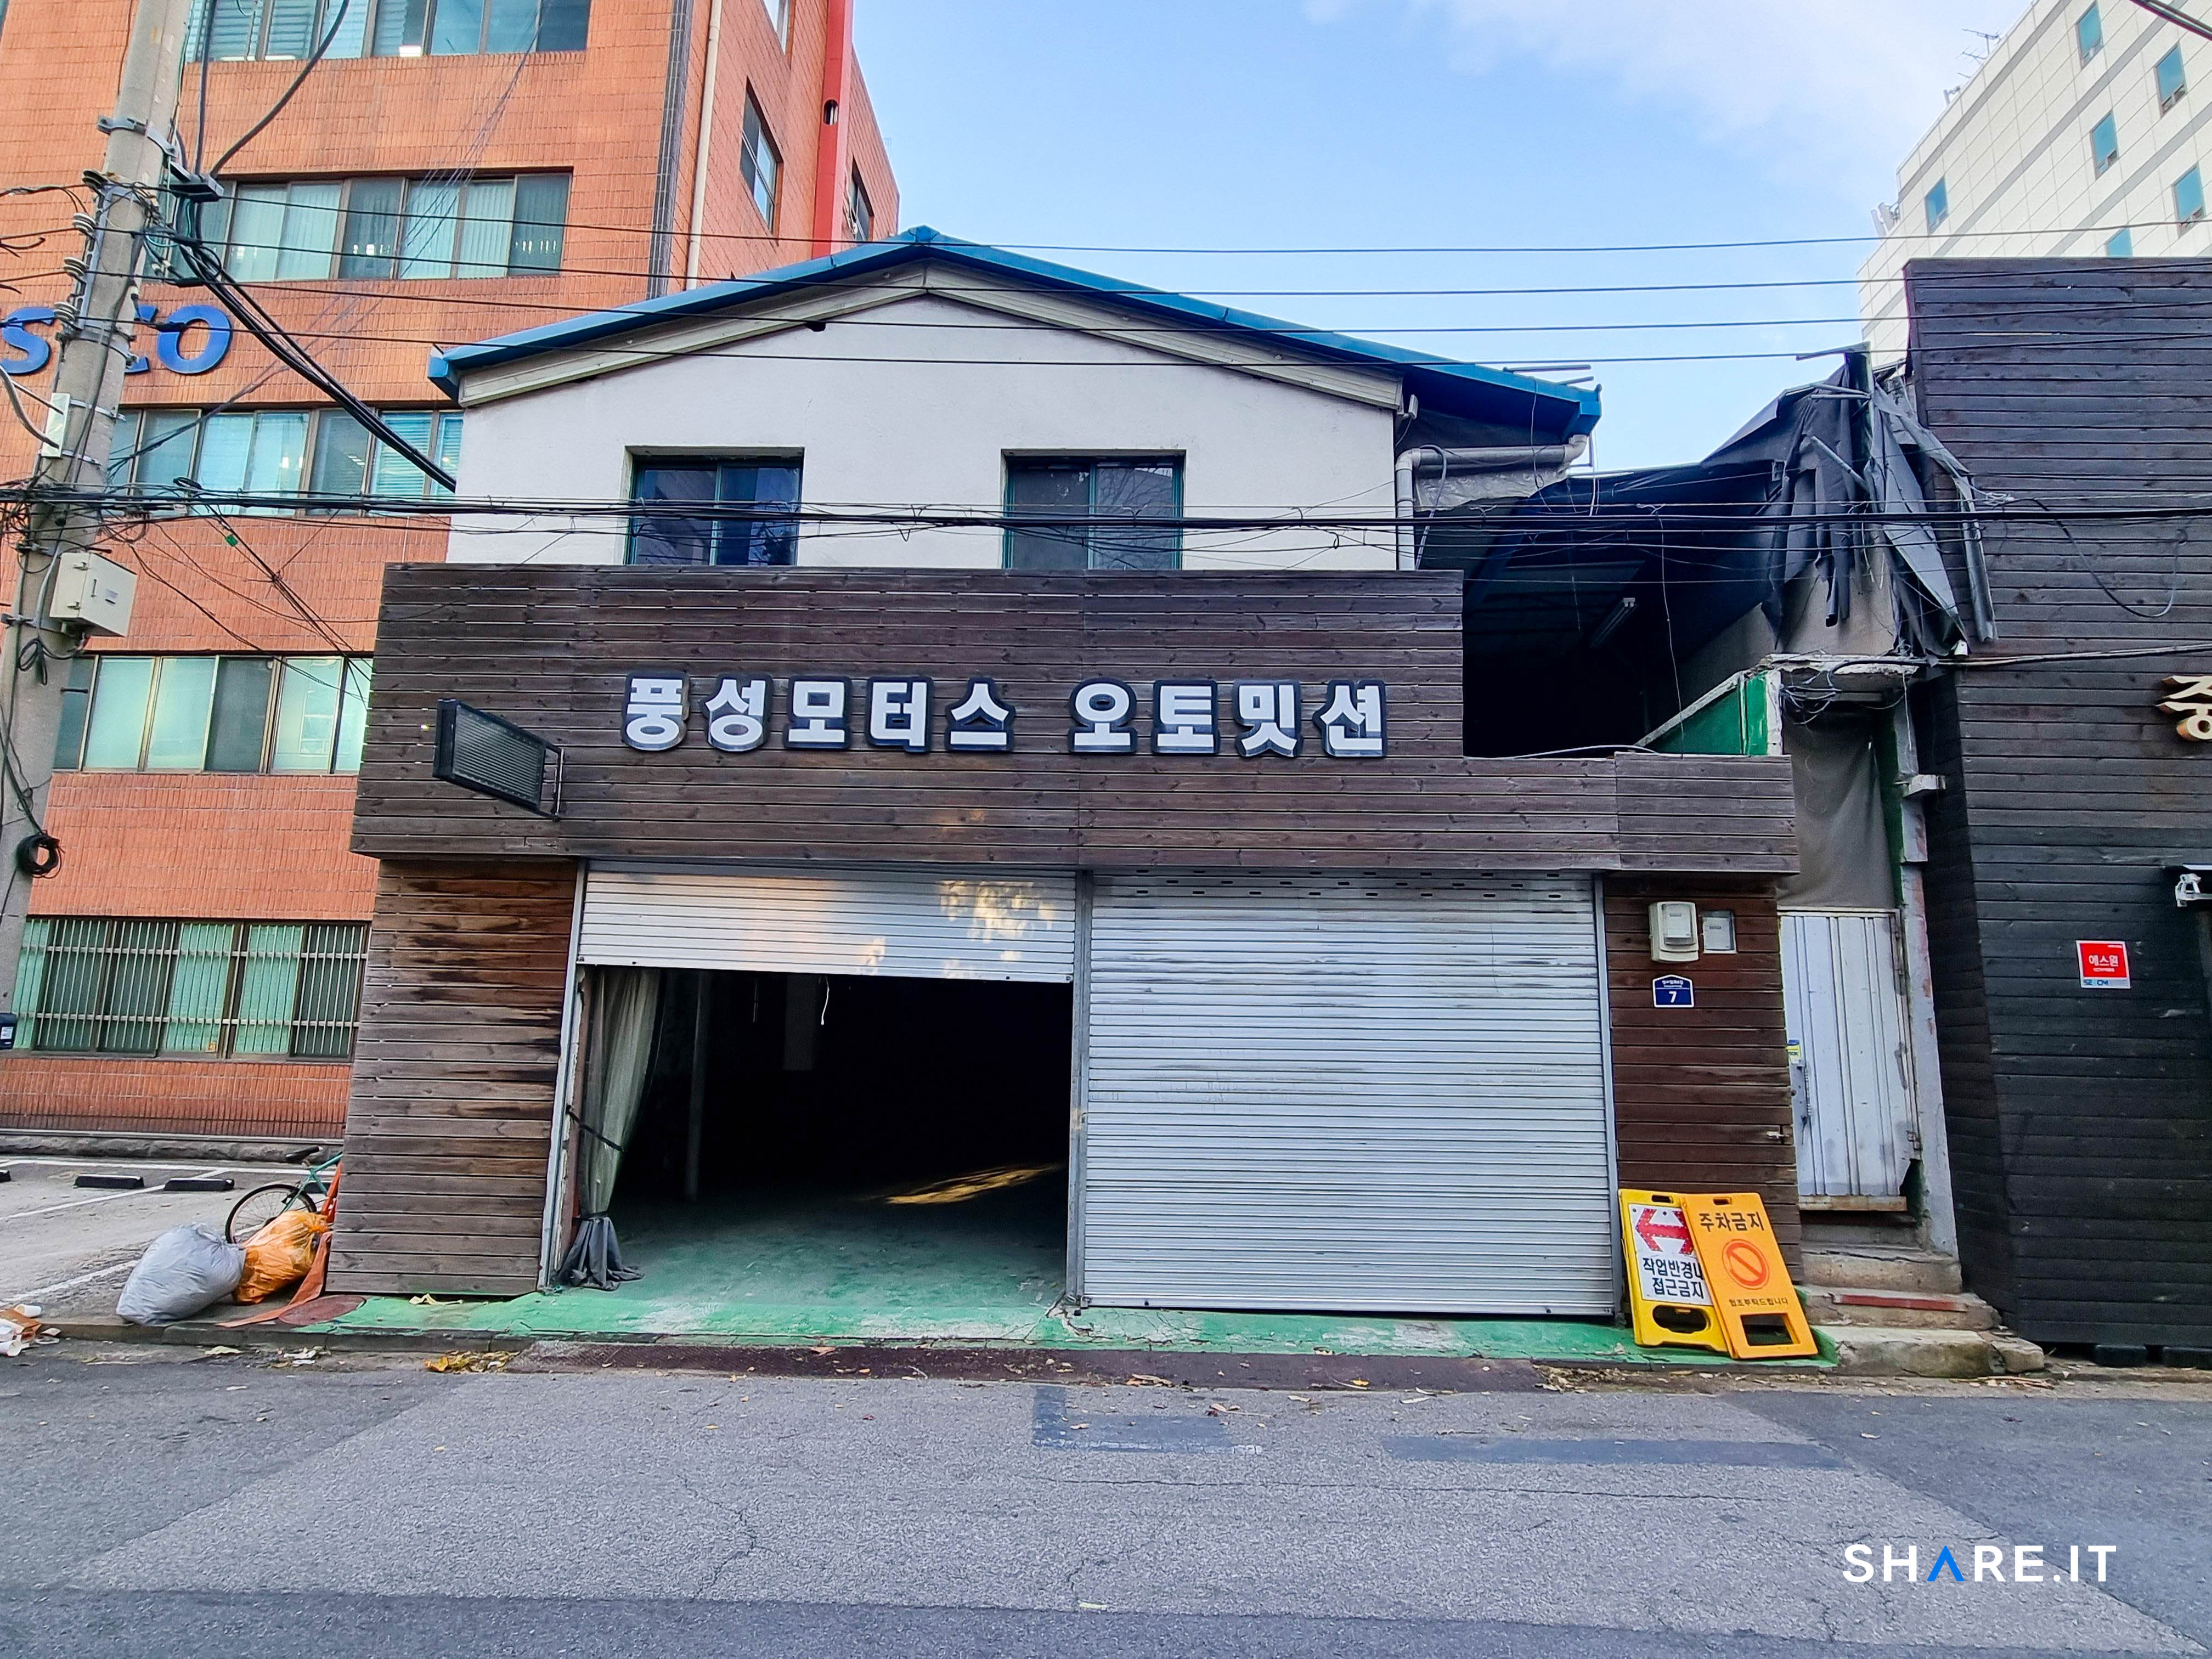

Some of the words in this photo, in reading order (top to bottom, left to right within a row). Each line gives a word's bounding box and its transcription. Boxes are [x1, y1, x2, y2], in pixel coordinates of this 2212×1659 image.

[624, 678, 1010, 750] 풍성모터스
[1074, 684, 1383, 757] 오토밋션
[2089, 955, 2118, 967] 에스원
[1669, 991, 1677, 1002] 7
[1699, 1211, 1764, 1232] 주차금지
[1652, 1278, 1704, 1299] 접근금지
